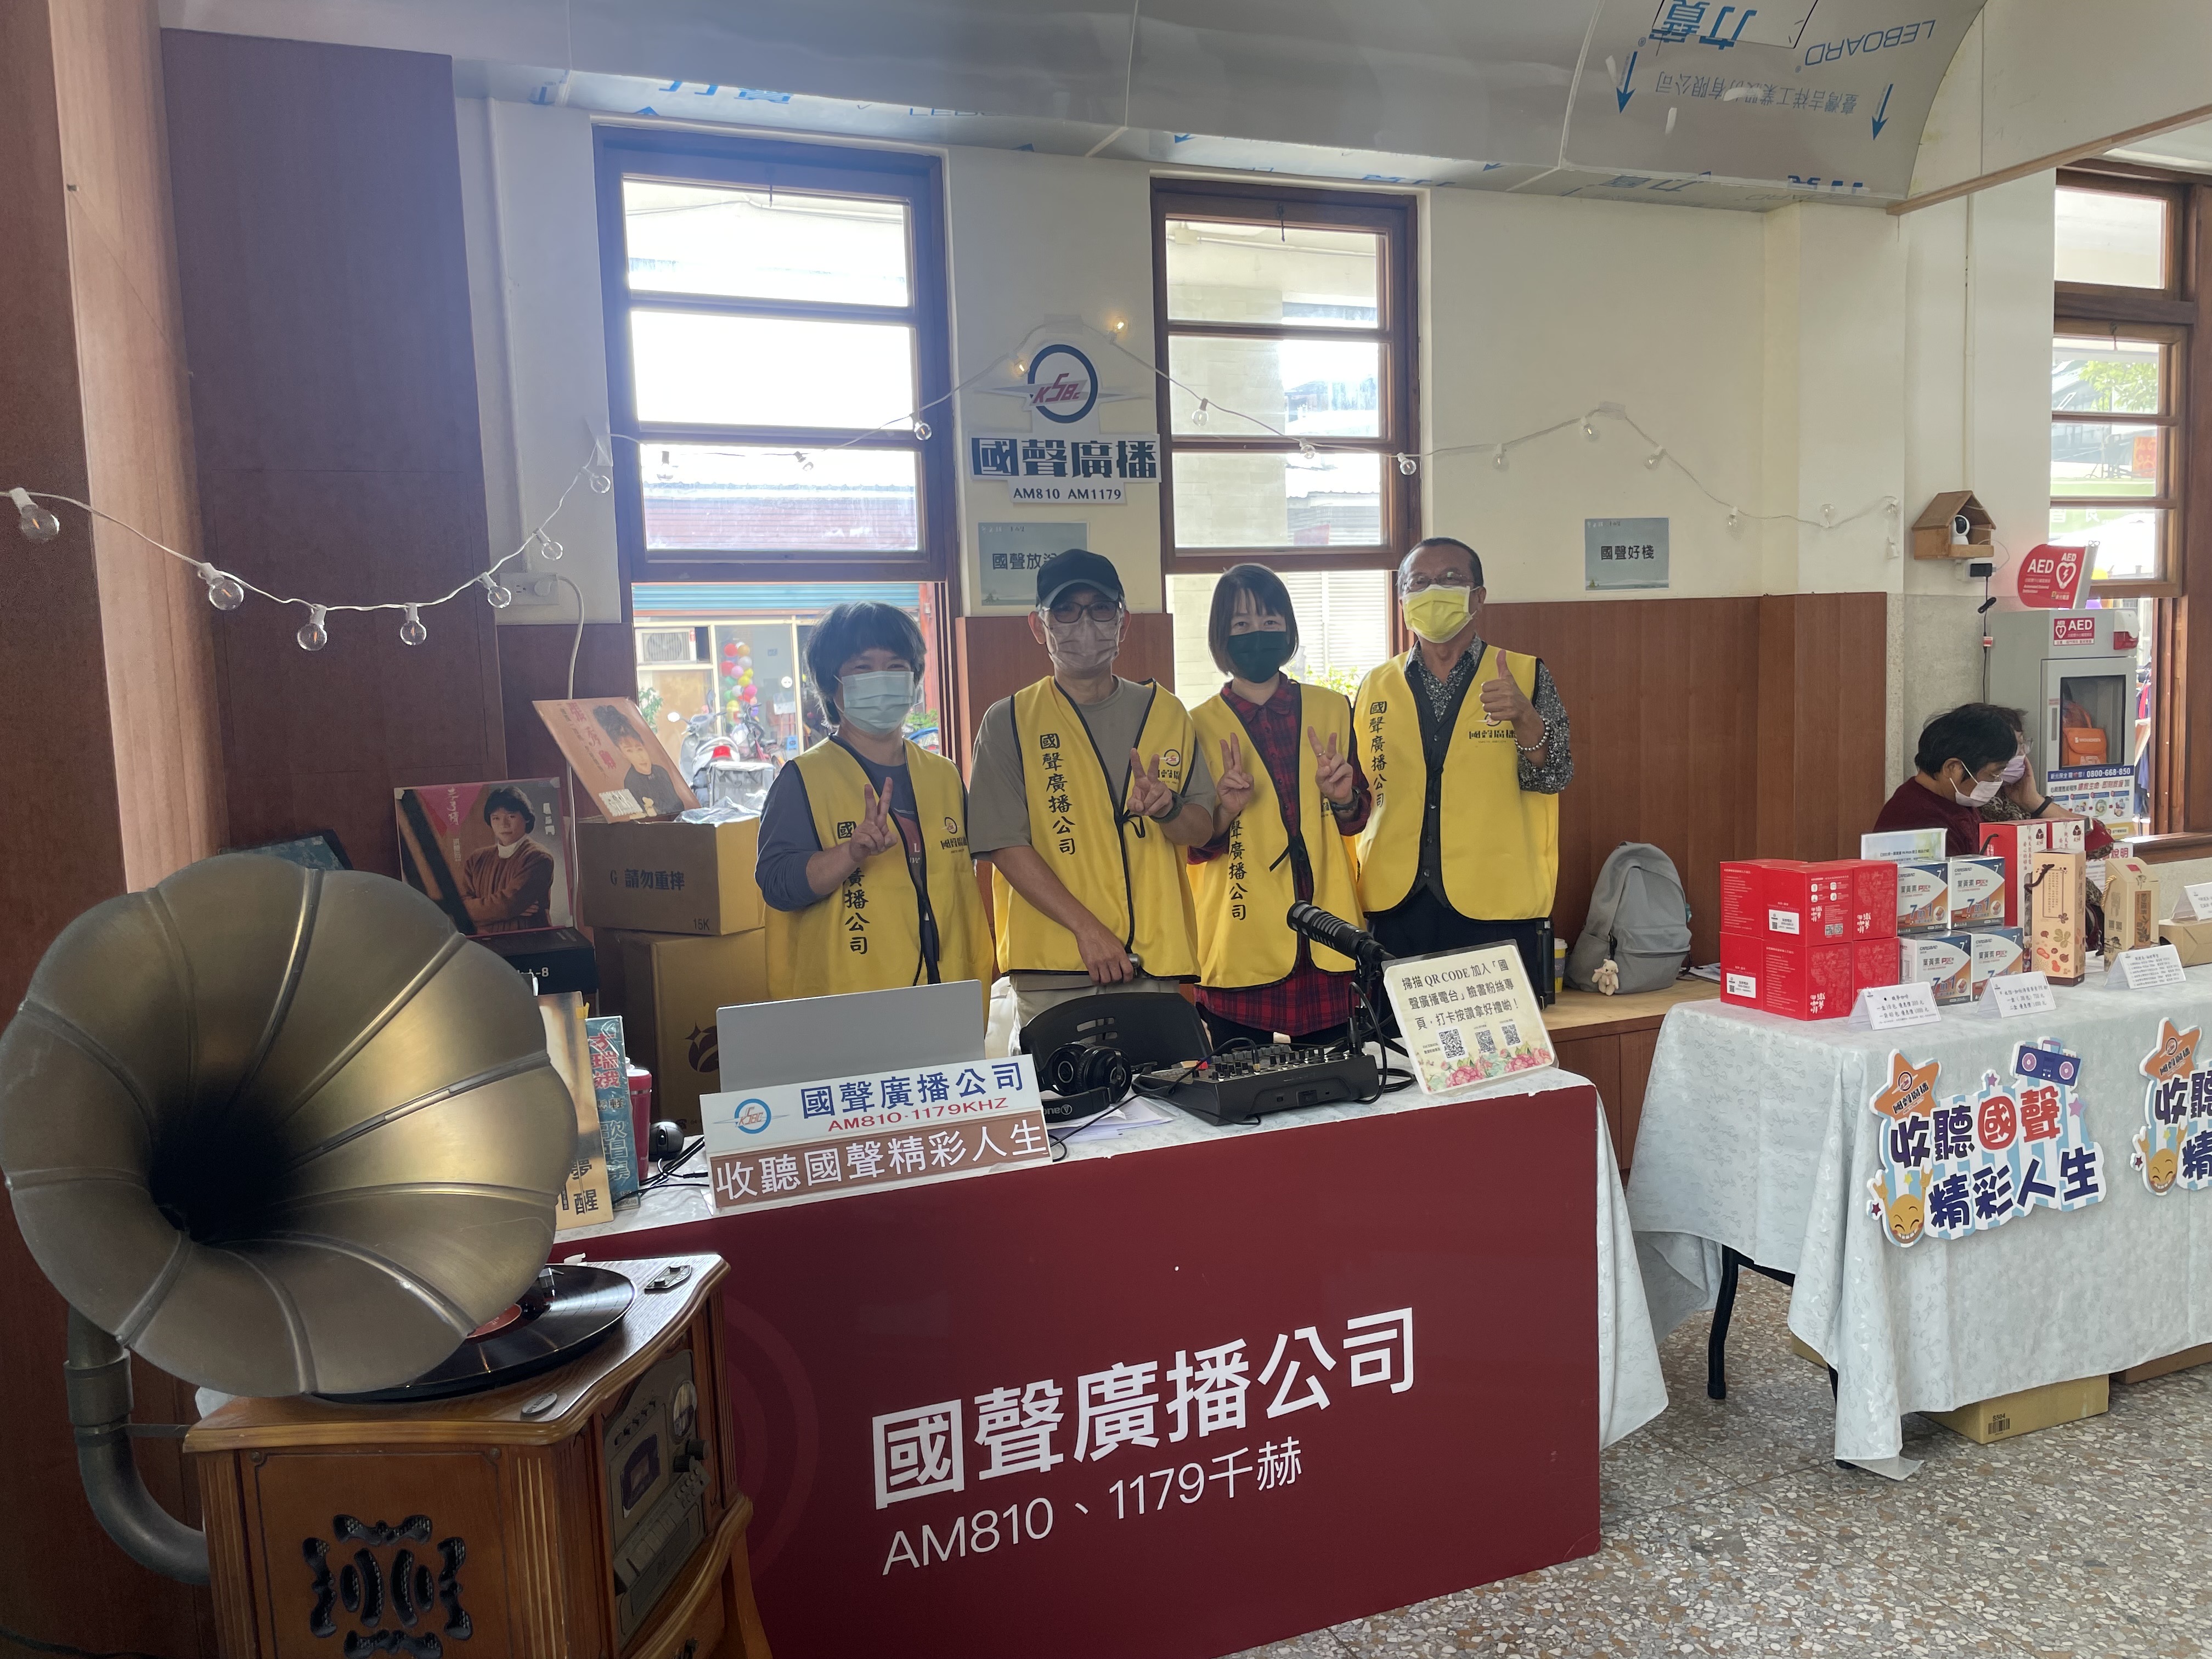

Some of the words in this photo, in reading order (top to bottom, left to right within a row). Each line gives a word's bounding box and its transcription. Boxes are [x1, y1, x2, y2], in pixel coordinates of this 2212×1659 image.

[1805, 19, 1936, 66] LEBOARD
[972, 438, 1157, 478] 國聲廣播
[1013, 488, 1060, 500] AM810
[1068, 488, 1121, 500] AM1179
[2027, 558, 2055, 574] AED
[2061, 552, 2077, 562] AED
[2068, 619, 2093, 631] AED
[1369, 701, 1387, 808] 國聲廣播公司
[2086, 768, 2131, 777] 0800-668-850
[1040, 733, 1076, 855] 國聲廣播公司
[625, 868, 685, 890] 請勿重摔
[1228, 811, 1248, 921] 聲廣播公司
[1402, 975, 1423, 991] 掃描
[1424, 974, 1440, 987] QR
[1441, 968, 1470, 983] CODE
[1471, 958, 1509, 978] 加入「國
[801, 1062, 1024, 1119] 國聲廣播公司
[1891, 1085, 2061, 1169] 收聽國聲
[716, 1119, 1047, 1200] 收聽國聲精彩人生
[1928, 1147, 2099, 1229] 精彩人生
[872, 1307, 1415, 1510] 國聲廣播公司
